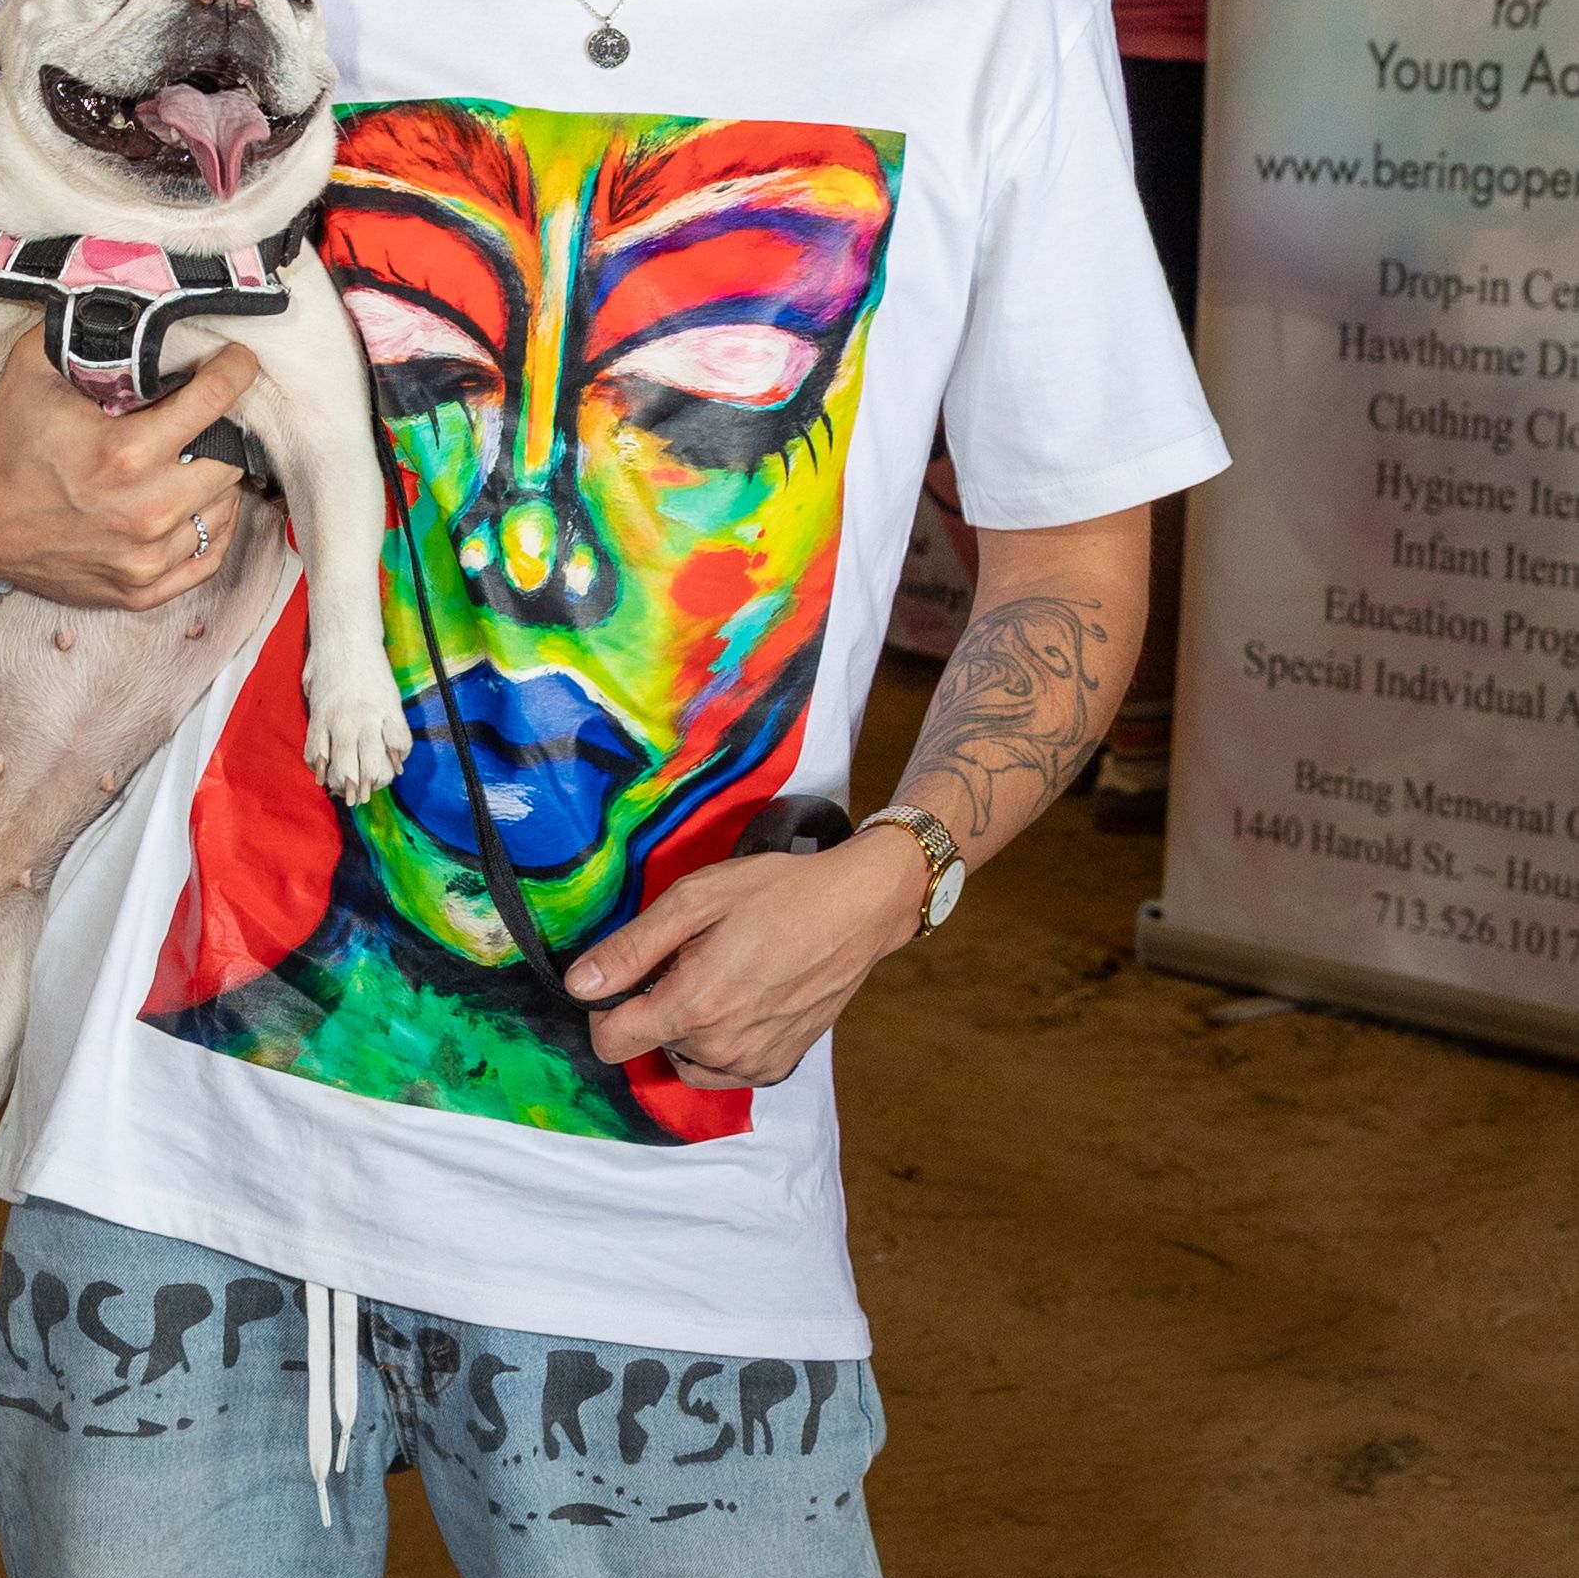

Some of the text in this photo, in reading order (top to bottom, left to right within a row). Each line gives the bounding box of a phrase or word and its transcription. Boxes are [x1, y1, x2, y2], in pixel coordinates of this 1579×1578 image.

[1367, 38, 1503, 111] Young
[1255, 141, 1579, 210] www.beringope
[1379, 257, 1579, 313] Drop-in Ce
[1338, 322, 1525, 376] Hawthorne
[1368, 392, 1513, 456] Clothing
[1375, 459, 1579, 520] Hygiene Ite
[1392, 528, 1490, 579] Infant
[1325, 585, 1488, 646] Education
[1244, 639, 1363, 693] Special
[1374, 658, 1547, 721] Individual
[1294, 758, 1393, 818] Bering
[1403, 776, 1556, 837] Memorial
[1232, 806, 1303, 849] 1440
[1310, 821, 1414, 872] Harold
[1423, 840, 1464, 882] St.
